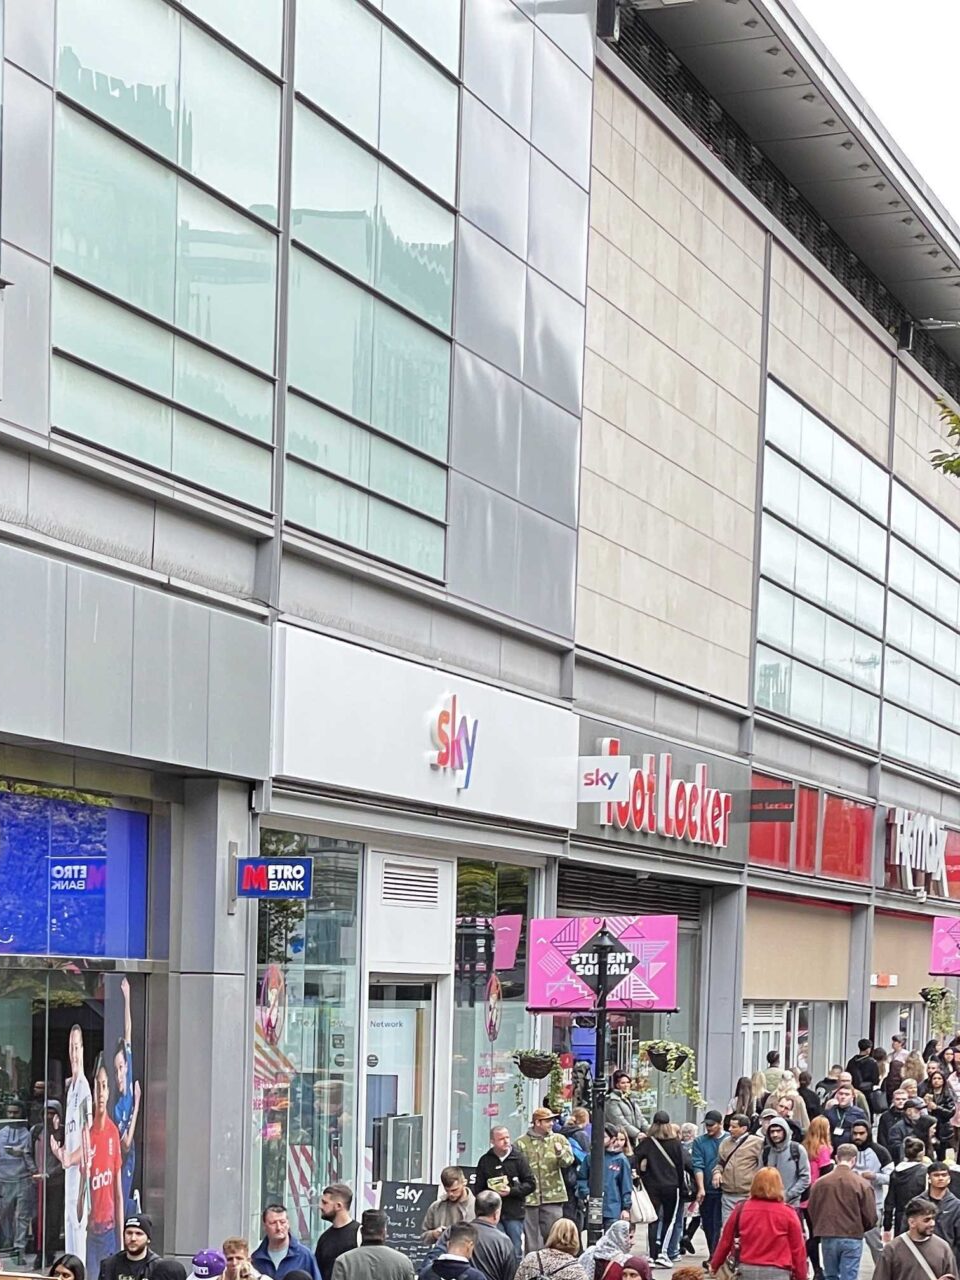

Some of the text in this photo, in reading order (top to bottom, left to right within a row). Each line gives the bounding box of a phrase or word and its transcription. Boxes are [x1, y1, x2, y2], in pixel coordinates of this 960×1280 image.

[431, 693, 478, 790] sky
[583, 768, 619, 790] sky
[658, 753, 732, 848] Locker
[242, 864, 305, 891] METRO
[268, 880, 305, 892] BANK
[570, 952, 635, 965] STUENT
[370, 1020, 403, 1029] Network
[92, 1167, 113, 1190] cinch
[396, 1185, 423, 1203] sky
[396, 1203, 409, 1213] NEW
